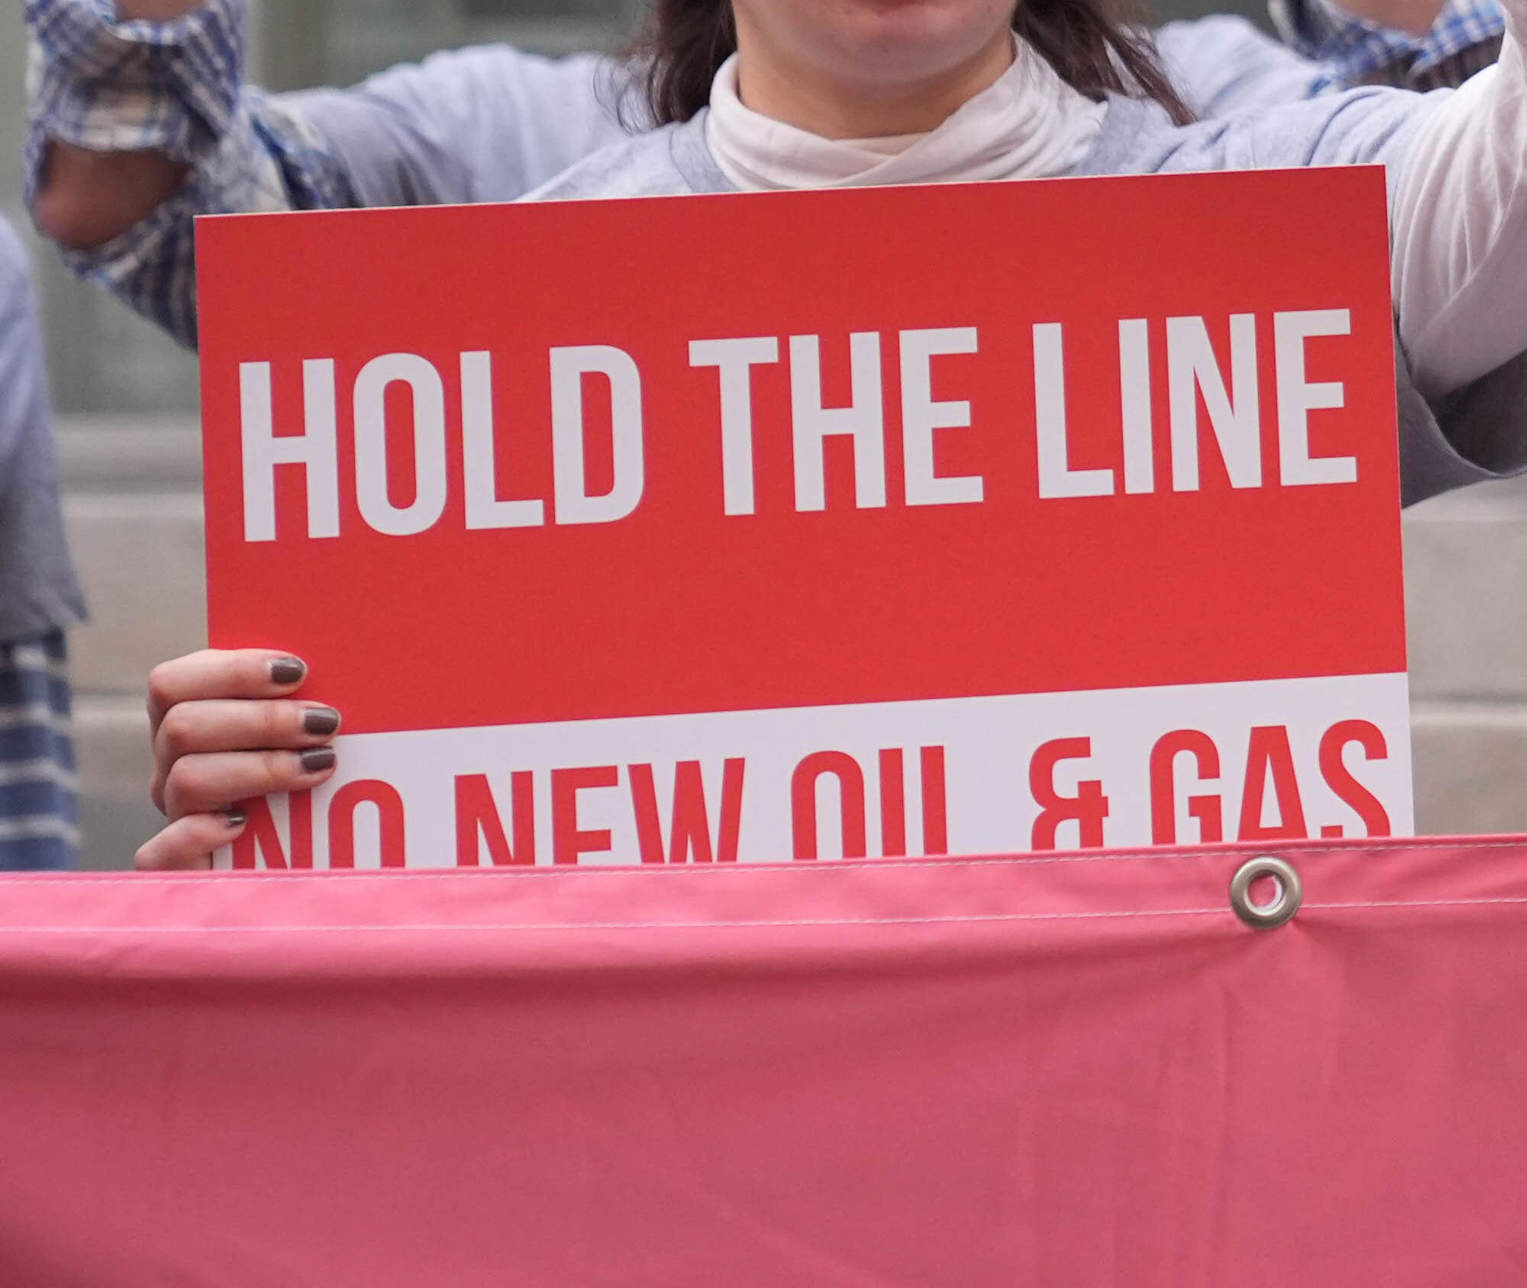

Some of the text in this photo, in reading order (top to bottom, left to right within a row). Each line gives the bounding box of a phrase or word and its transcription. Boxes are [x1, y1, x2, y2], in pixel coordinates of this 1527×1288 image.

[239, 308, 1358, 542] HOLD THE LINE
[1149, 718, 1392, 846] GAS
